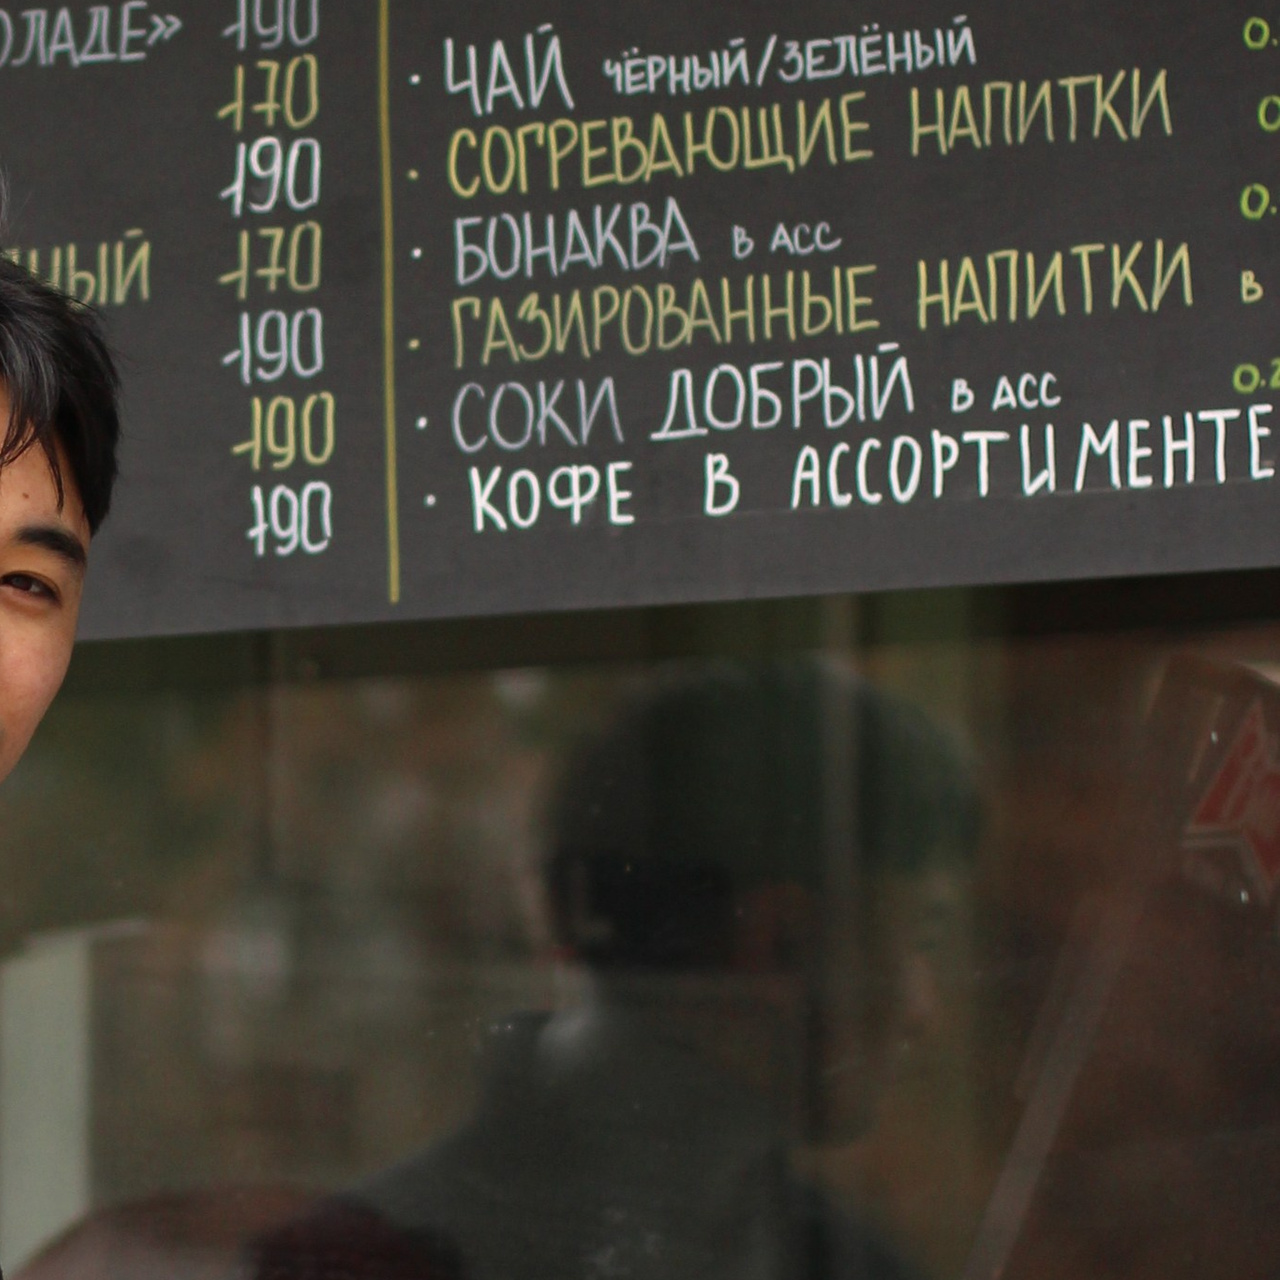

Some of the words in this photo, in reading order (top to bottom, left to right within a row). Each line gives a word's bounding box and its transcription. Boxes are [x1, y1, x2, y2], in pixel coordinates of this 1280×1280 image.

[217, 54, 319, 132] 170
[443, 23, 574, 117] ЧАЙ
[447, 91, 874, 198] СОГРЕВАЮЩИЕ
[910, 67, 1172, 156] НАПИТКИ
[219, 135, 321, 217] 190
[218, 221, 322, 299] 170
[454, 196, 700, 286] БОНАКВА
[732, 225, 754, 259] В
[770, 222, 842, 255] АСС
[451, 264, 880, 368] ГАЗИРОВАННЫЕ
[917, 238, 1193, 330] НАПИТКИ
[1240, 270, 1263, 304] В
[222, 307, 324, 385] 190
[232, 391, 335, 470] 190
[451, 377, 624, 453] СОКИ
[650, 342, 914, 441] ДОБРЫЙ
[951, 378, 975, 413] В
[991, 372, 1061, 411] АСС
[247, 480, 332, 556] 190
[468, 461, 635, 533] КОФЕ
[704, 453, 740, 517] В
